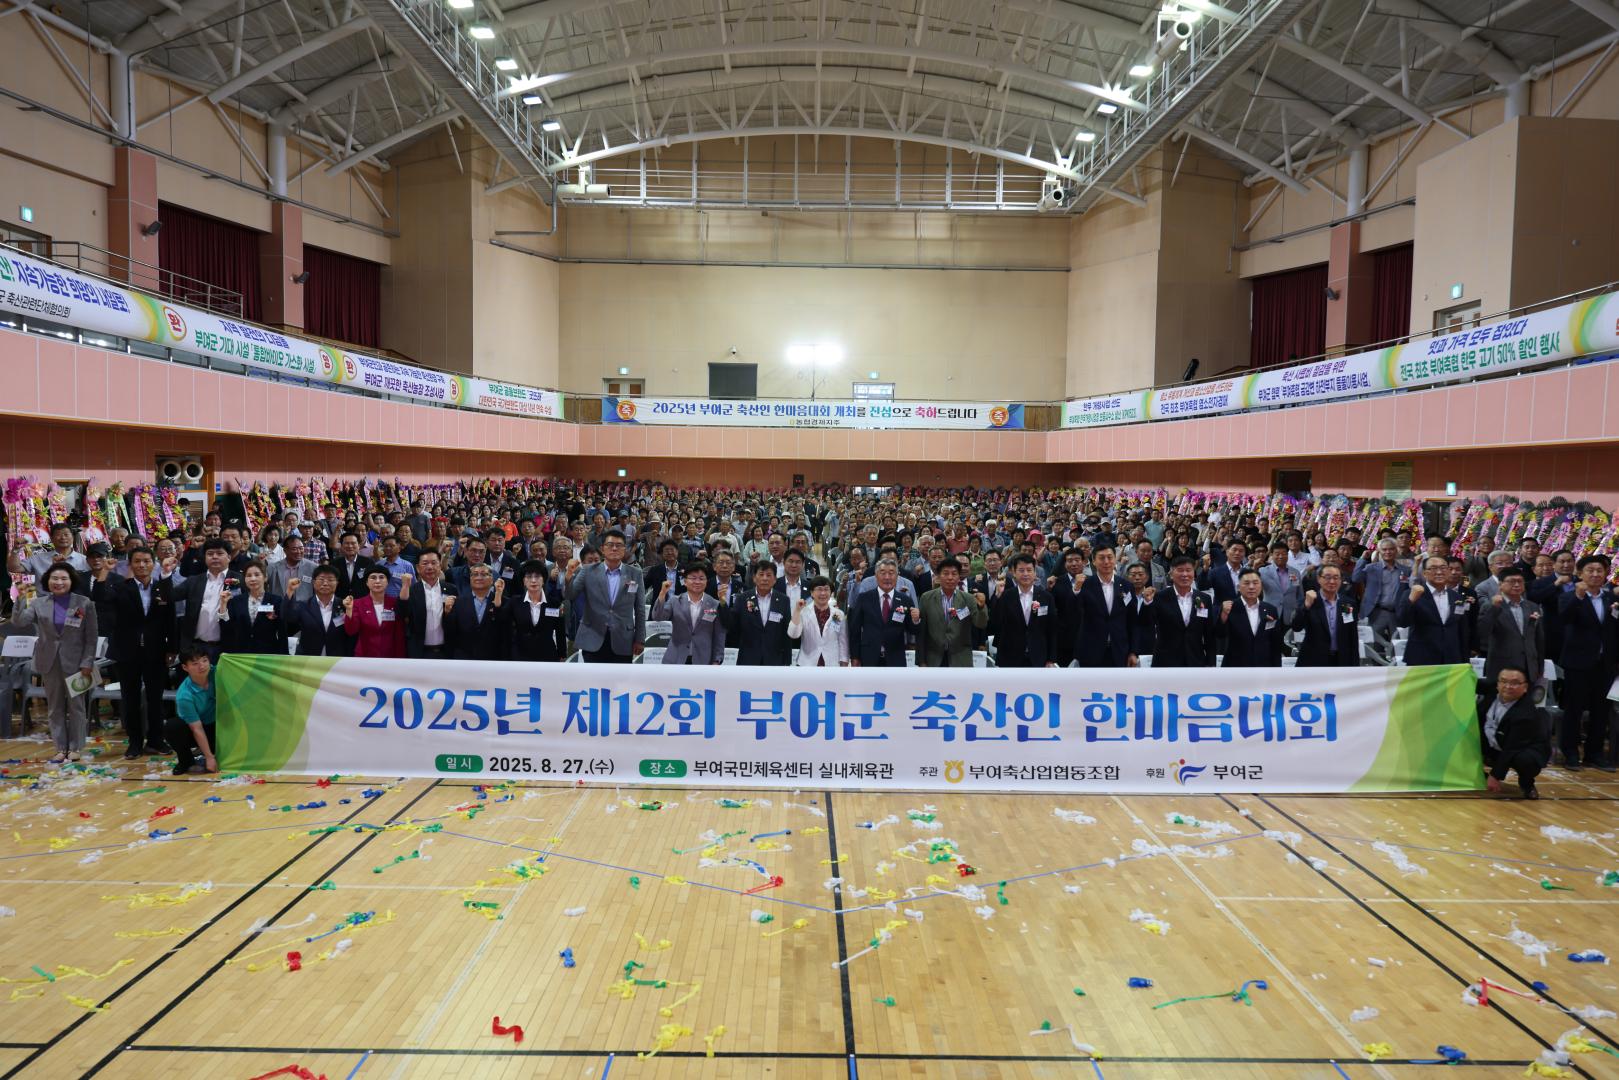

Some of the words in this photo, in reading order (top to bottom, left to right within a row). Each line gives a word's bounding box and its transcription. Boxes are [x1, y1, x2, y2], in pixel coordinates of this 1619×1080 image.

[11, 260, 70, 297] 지속가능한
[66, 277, 100, 306] 희망의
[7, 292, 71, 318] 축산관련단체협의회
[219, 320, 241, 336] 지역
[238, 325, 267, 343] 발전의
[264, 332, 289, 349] 디딤돌
[1428, 338, 1448, 355] 맛과
[1448, 332, 1470, 350] 가격
[1469, 328, 1492, 346] 모두
[1492, 319, 1528, 341] 잡았다
[195, 330, 217, 351] 부여군
[219, 336, 234, 355] 기대
[236, 341, 249, 358] 시설
[285, 353, 303, 370] 가스화
[1401, 363, 1414, 381] 전국
[1415, 360, 1429, 378] 최초
[1430, 354, 1459, 376] 부여축협
[1461, 350, 1476, 371] 한우
[1479, 346, 1495, 367] 고기
[1497, 342, 1516, 363] 50%
[1519, 336, 1537, 359] 할인
[1540, 331, 1560, 355] 행사
[1333, 360, 1347, 374] 위한
[364, 372, 383, 388] 부여군
[385, 377, 401, 391] 깨끗한
[403, 382, 424, 395] 축산농장
[425, 386, 445, 399] 조성사업
[1259, 388, 1270, 401] 부여군
[621, 405, 633, 416] 축
[653, 402, 695, 414] 2025년
[700, 403, 733, 415] 부여군
[737, 404, 770, 416] 축산인
[774, 404, 830, 417] 한마음대회
[835, 405, 866, 417] 개최를
[870, 406, 911, 418] 진심으로
[915, 406, 977, 419] 축하드립니다
[992, 410, 1005, 422] 축
[796, 418, 840, 426] 농협경제지주
[358, 686, 541, 735] 2025년
[562, 688, 716, 739] 제12회
[736, 690, 888, 742] 부여군
[909, 691, 1061, 743] 축산인
[1081, 691, 1337, 744] 한마음대회
[693, 760, 813, 779] 부여국민체육센터
[818, 763, 895, 780] 실내체육관
[919, 766, 938, 777] 주관
[969, 764, 1120, 781] 부여축산업협동조합
[1145, 767, 1165, 778] 후원
[1212, 764, 1264, 781] 부여군
